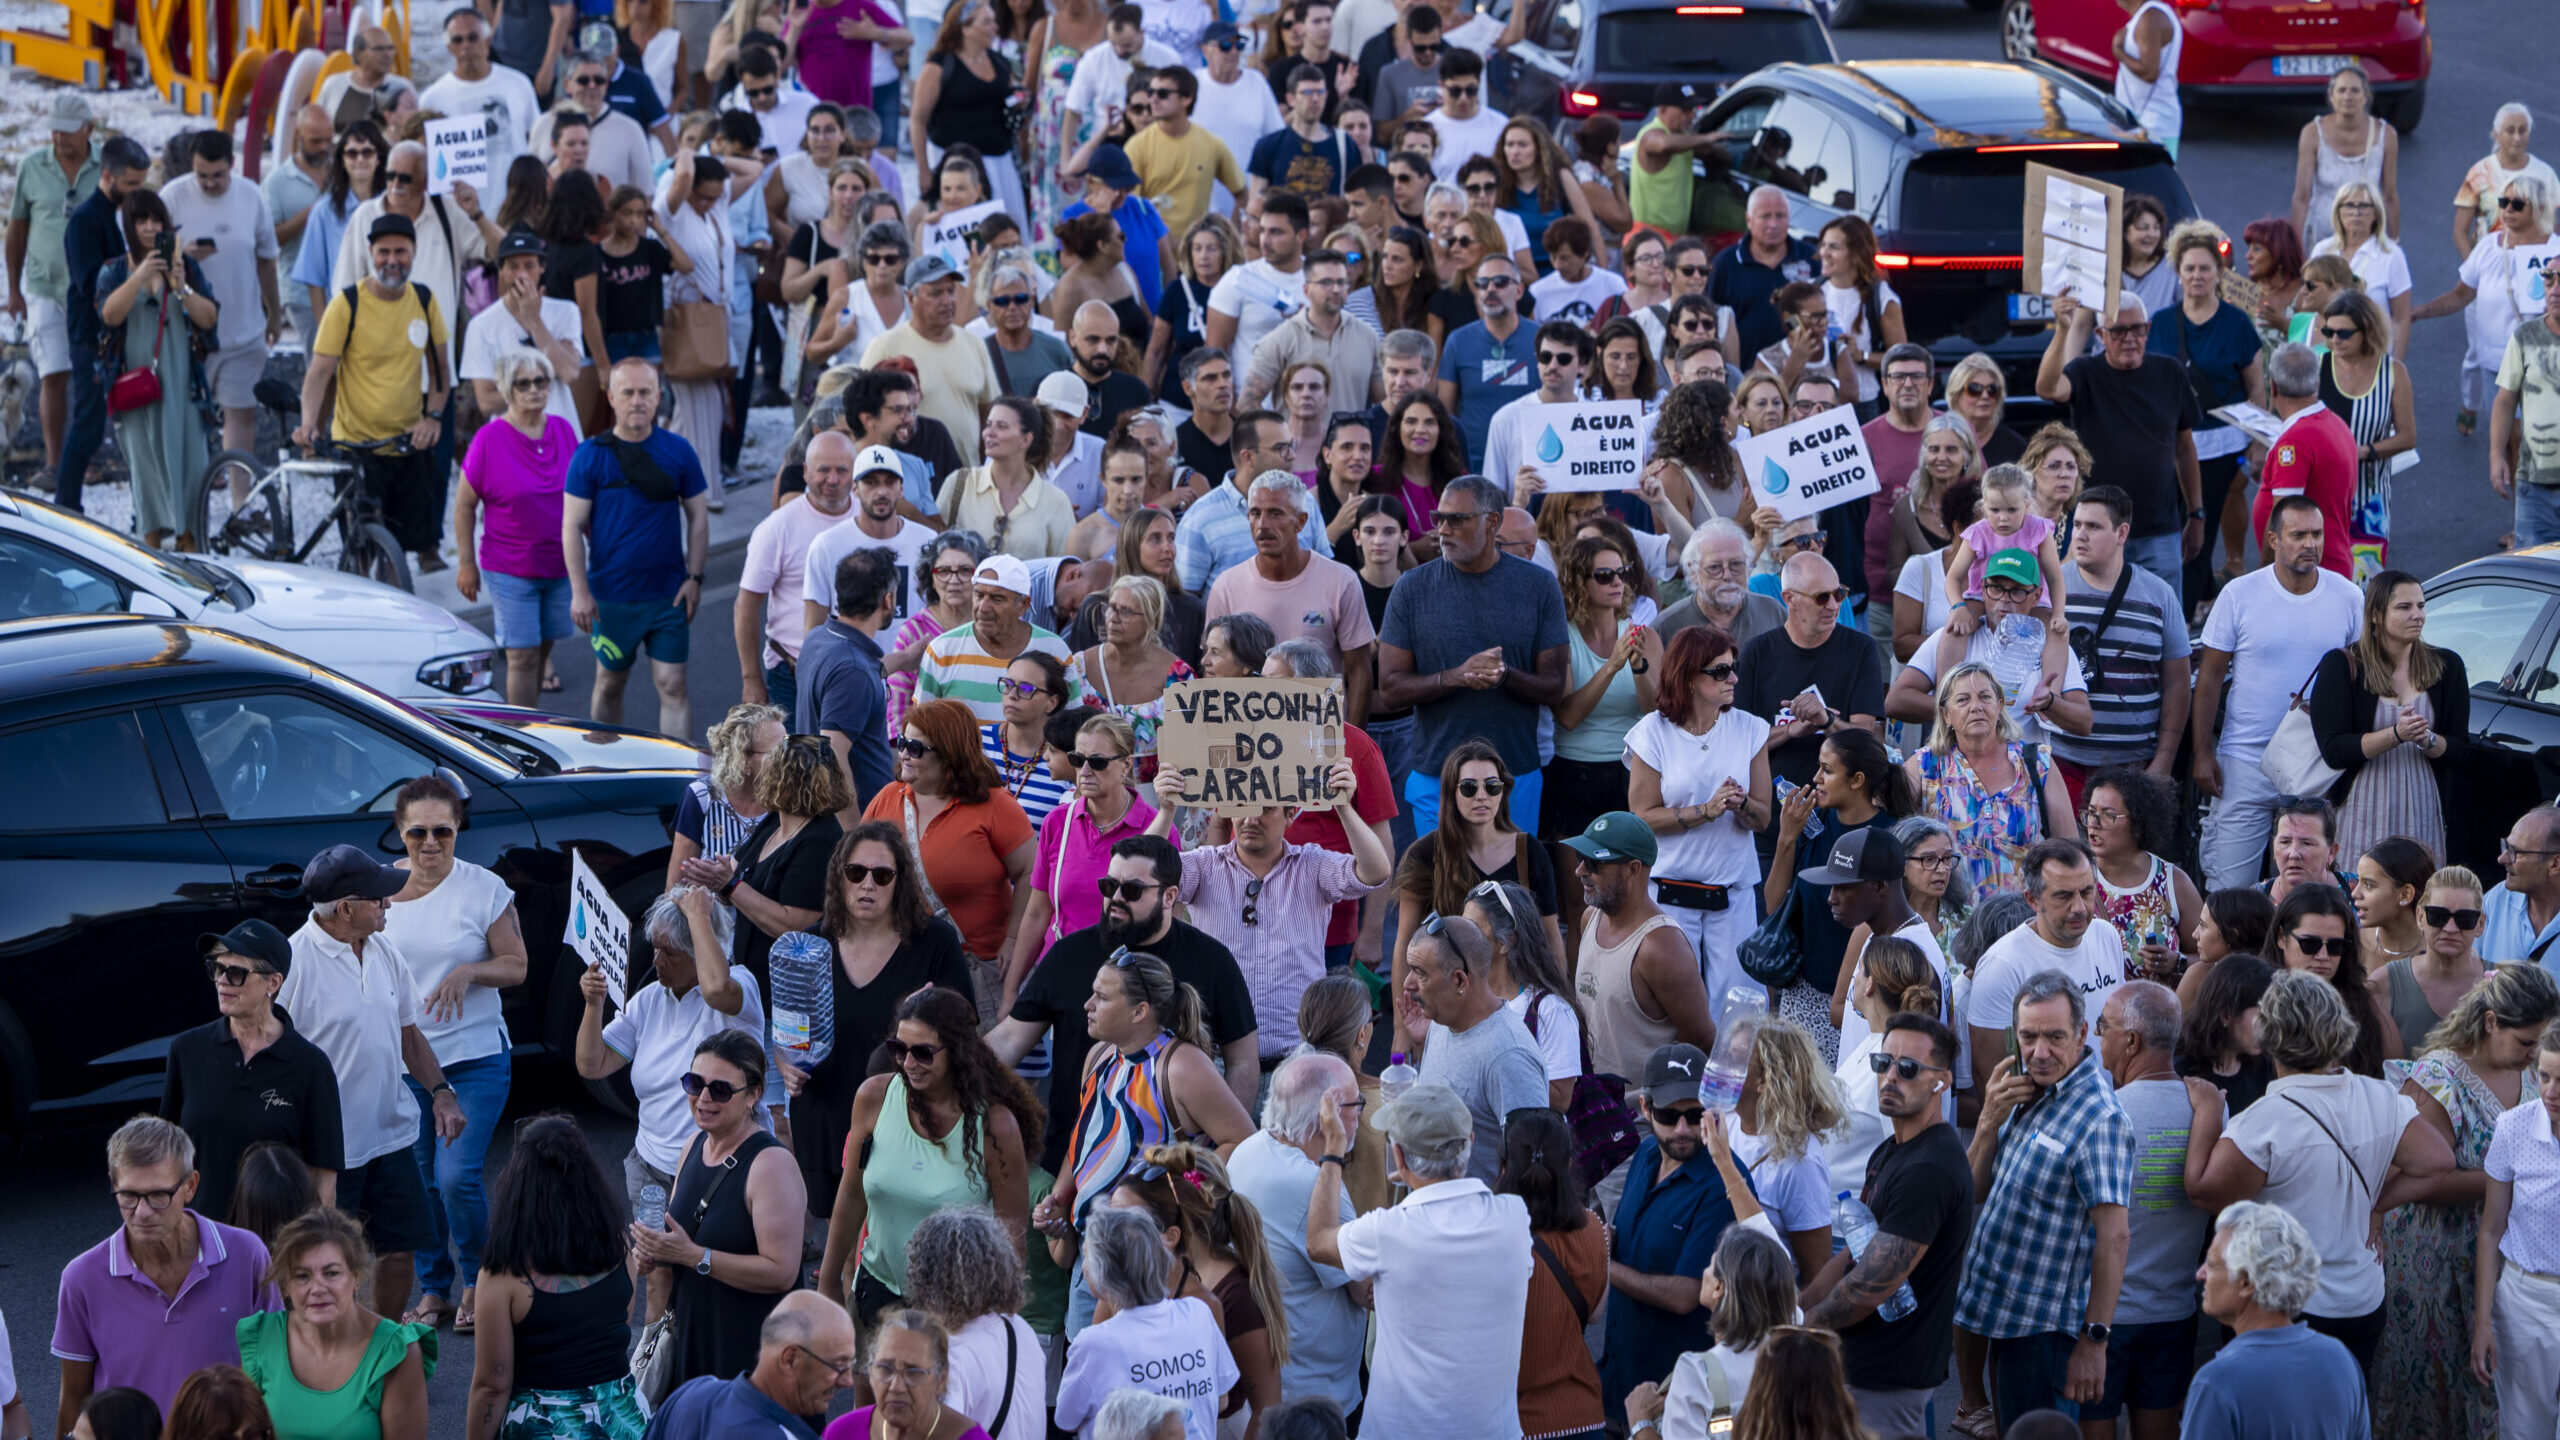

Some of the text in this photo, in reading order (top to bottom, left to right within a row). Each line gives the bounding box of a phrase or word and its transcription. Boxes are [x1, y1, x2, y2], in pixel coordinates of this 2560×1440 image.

[1570, 412, 1635, 431] ÁGUA
[1611, 437, 1635, 451] UM
[1788, 423, 1851, 457] ÁGUA
[1832, 444, 1859, 463] UM
[1570, 459, 1636, 476] DIREITO
[1800, 466, 1866, 499] DIREITO
[1174, 689, 1342, 727] VERGONHA
[1235, 732, 1283, 763] DO
[1178, 764, 1341, 803] CARALHO
[576, 875, 628, 953] ÁGUA JÁ
[594, 926, 618, 964] CHEGA
[1131, 1349, 1206, 1383] SOMOS
